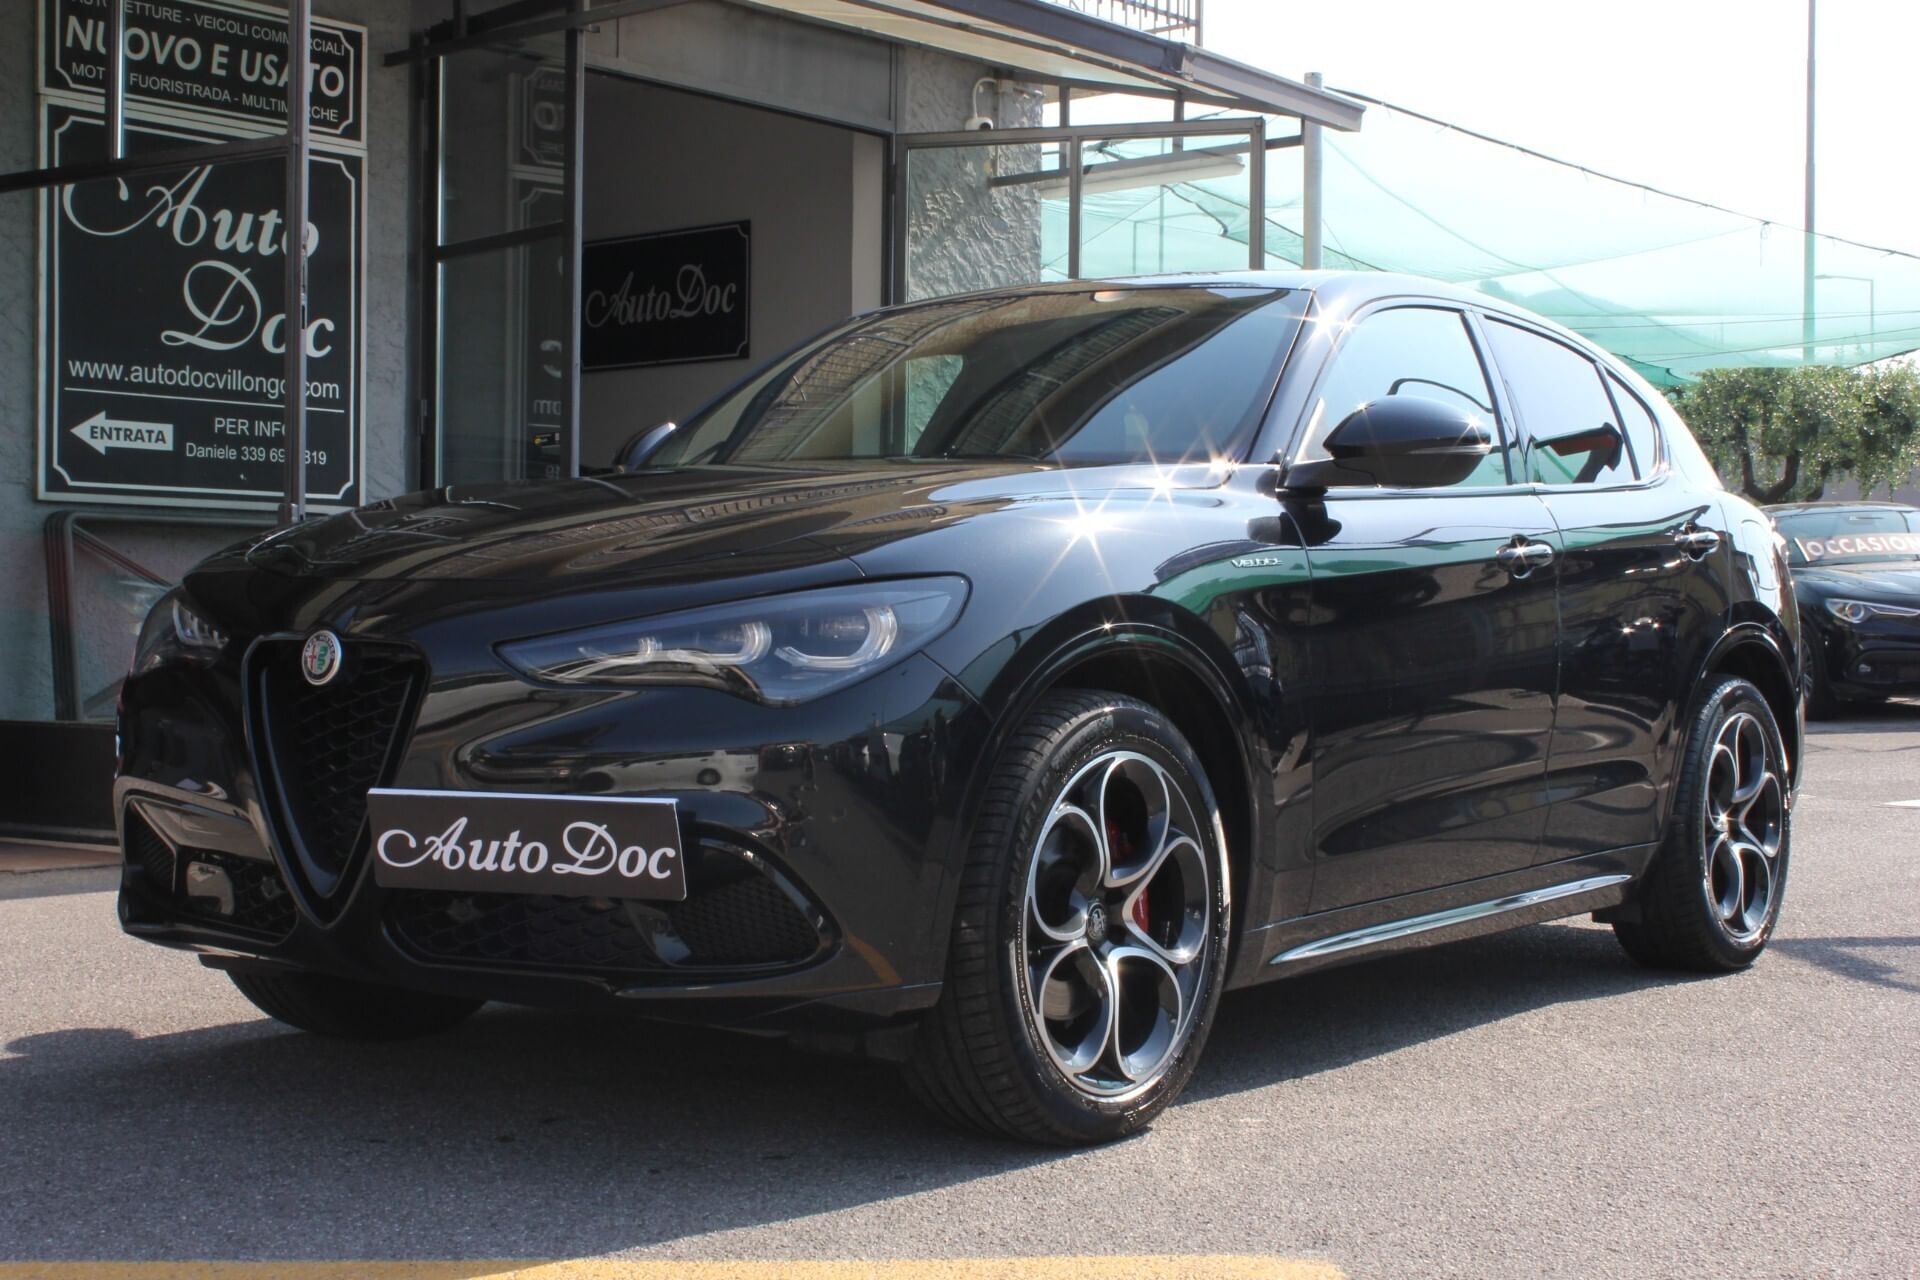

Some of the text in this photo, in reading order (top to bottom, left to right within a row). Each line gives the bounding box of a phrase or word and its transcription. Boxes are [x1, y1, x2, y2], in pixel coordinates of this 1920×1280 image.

[194, 13, 248, 36] VEICOLI
[251, 26, 345, 56] COMMCIALI
[210, 43, 230, 77] E
[72, 62, 107, 80] MOT
[129, 73, 232, 103] FUORISTRADA
[242, 93, 339, 122] MULTIMCHE
[160, 260, 335, 358] Doc
[585, 264, 737, 328] Auto Doc
[68, 360, 340, 400] www.autodocvillongcom
[90, 425, 167, 444] ENTRATA
[214, 417, 286, 437] PER INF
[186, 442, 237, 460] Daniele
[241, 446, 265, 462] 339
[377, 816, 676, 879] Auto Doc
